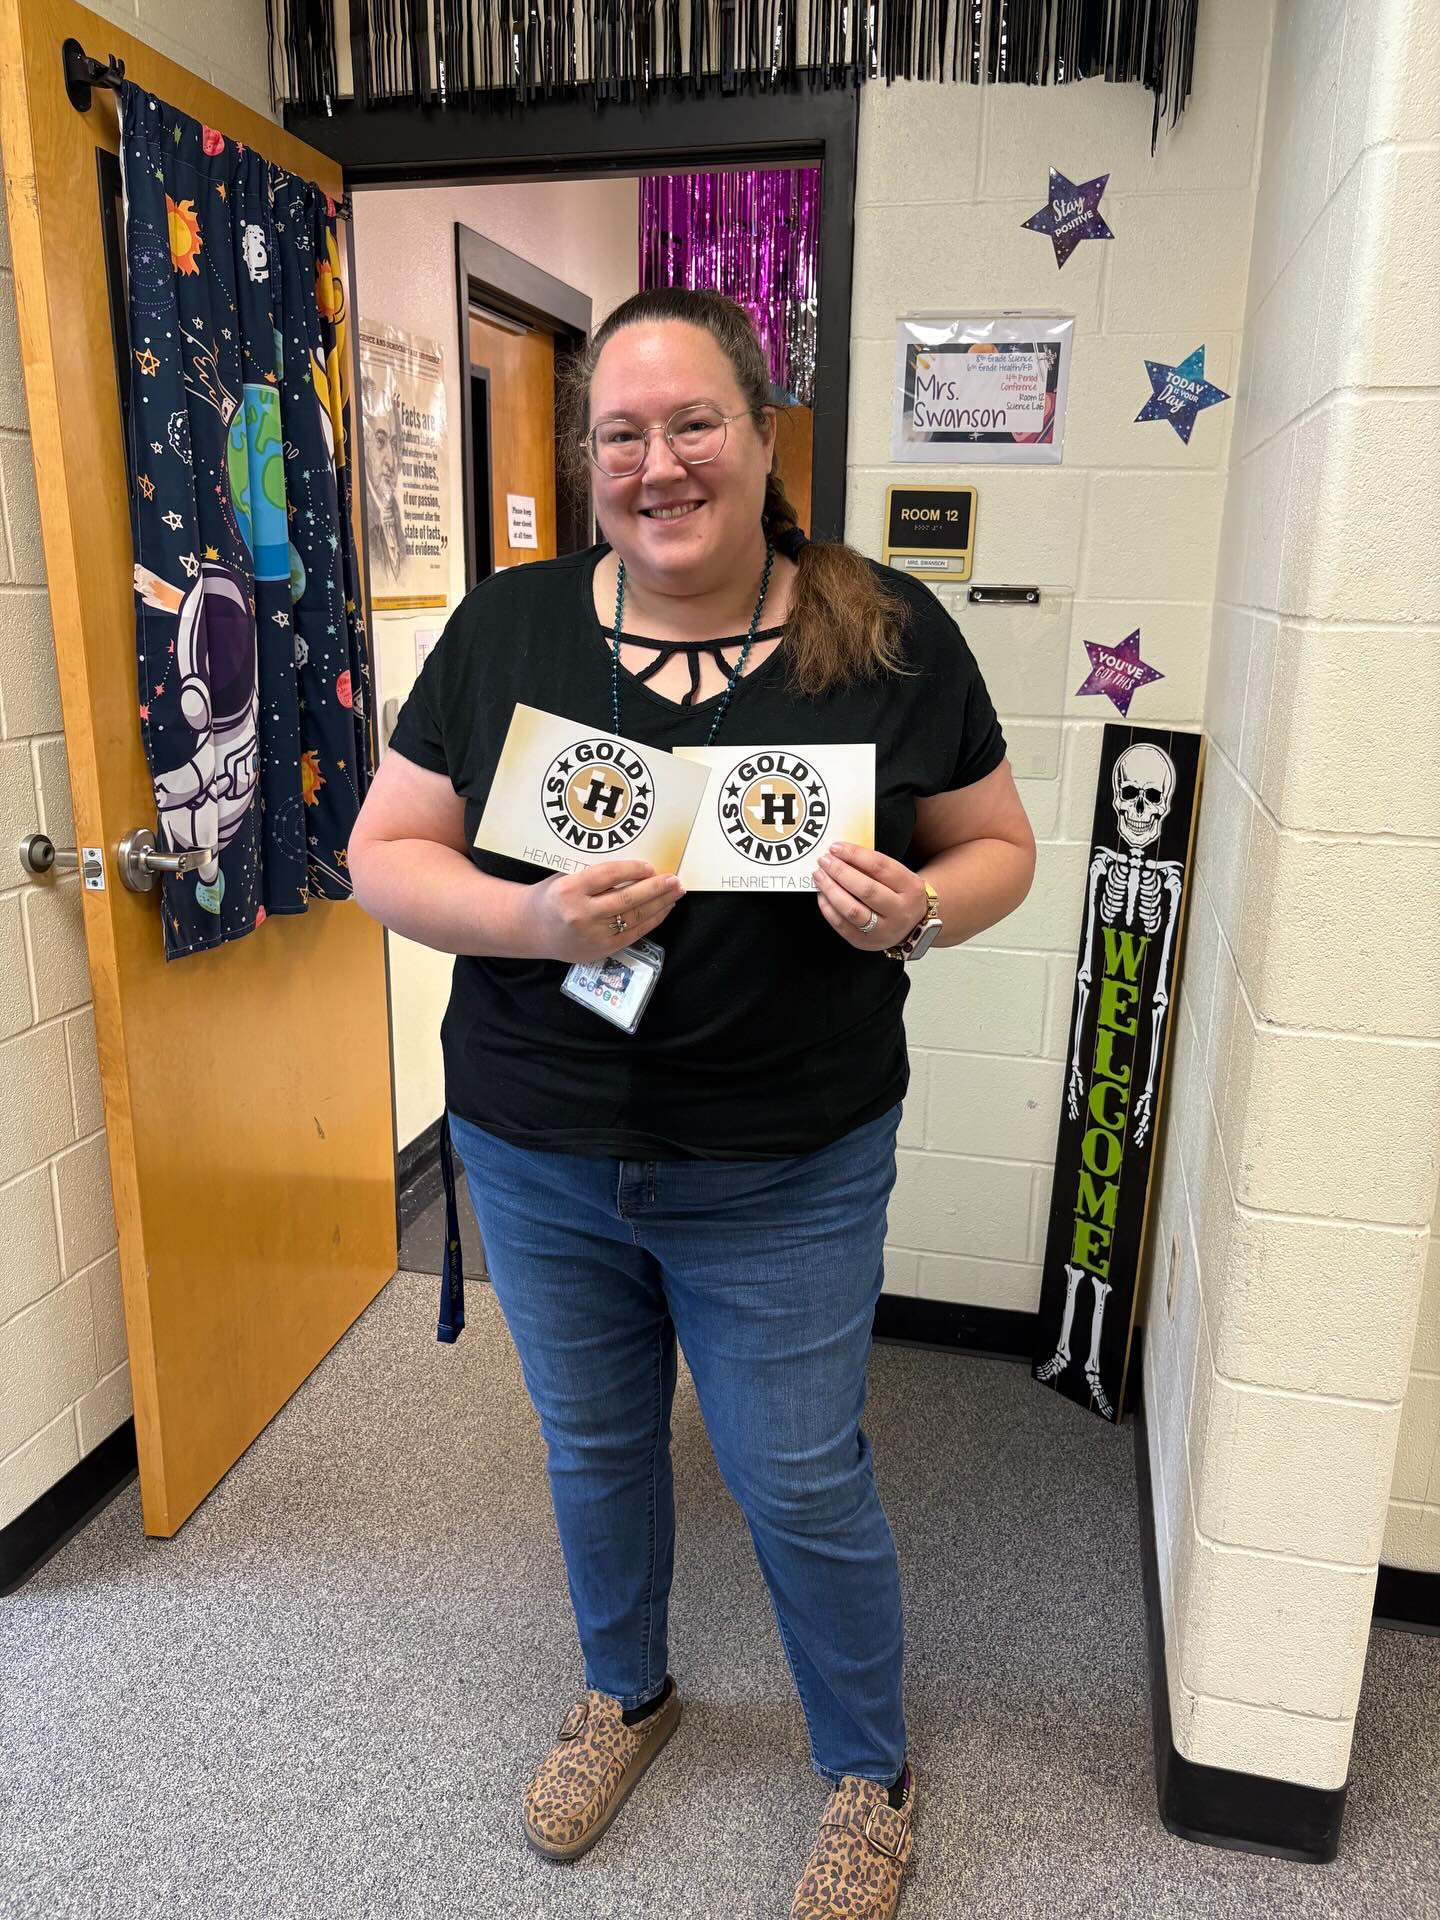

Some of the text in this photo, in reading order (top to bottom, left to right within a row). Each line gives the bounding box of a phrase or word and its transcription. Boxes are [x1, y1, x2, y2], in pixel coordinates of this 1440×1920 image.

[1053, 197, 1085, 221] Stay
[1054, 210, 1094, 237] POSITIVE
[916, 374, 959, 401] Mrs.
[1001, 383, 1037, 391] Conference
[1166, 372, 1204, 395] TODAY
[1180, 390, 1199, 403] YOUR
[1007, 402, 1045, 410] Science Lab
[1038, 393, 1044, 401] 12
[1157, 383, 1186, 413] Day
[914, 401, 1006, 428] Swanson
[901, 509, 959, 521] ROOM 12
[1095, 666, 1135, 690] GOT THIS
[1098, 652, 1144, 679] YOU'VE
[575, 743, 643, 779] GOLD
[738, 755, 809, 781] GOLD
[583, 779, 624, 818] H
[762, 793, 795, 824] H
[547, 776, 648, 849] STANDARD
[723, 800, 826, 861] STANDARD
[523, 846, 590, 872] HENRIETT
[722, 876, 796, 888] HENRIETTA
[1071, 926, 1151, 1279] WELCOME
